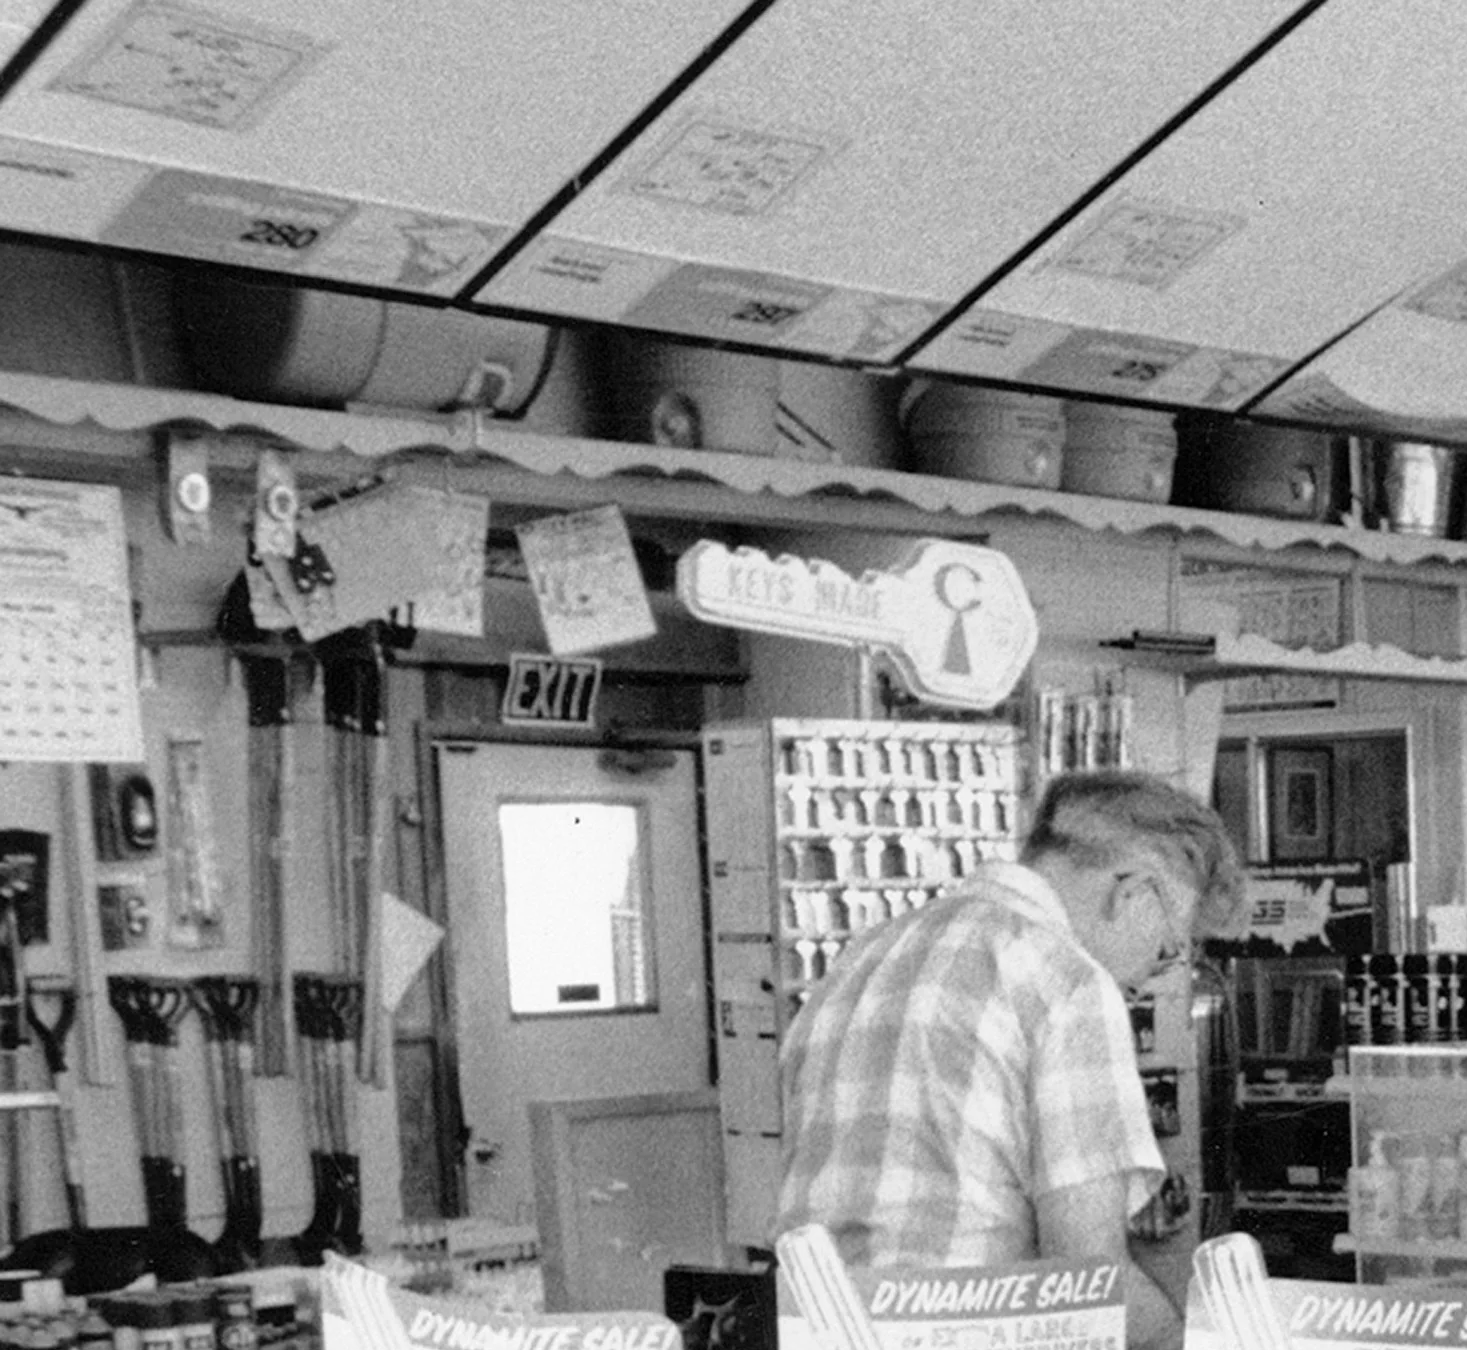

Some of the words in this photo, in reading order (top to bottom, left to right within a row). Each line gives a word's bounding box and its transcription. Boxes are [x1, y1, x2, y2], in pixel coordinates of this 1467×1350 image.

[728, 564, 795, 606] KEYS
[814, 580, 883, 619] MADE
[511, 662, 594, 719] EXIT
[871, 1273, 1036, 1315] DYNAMITE
[1036, 1264, 1119, 1307] SALE!
[1293, 1295, 1463, 1339] DYNAMITE
